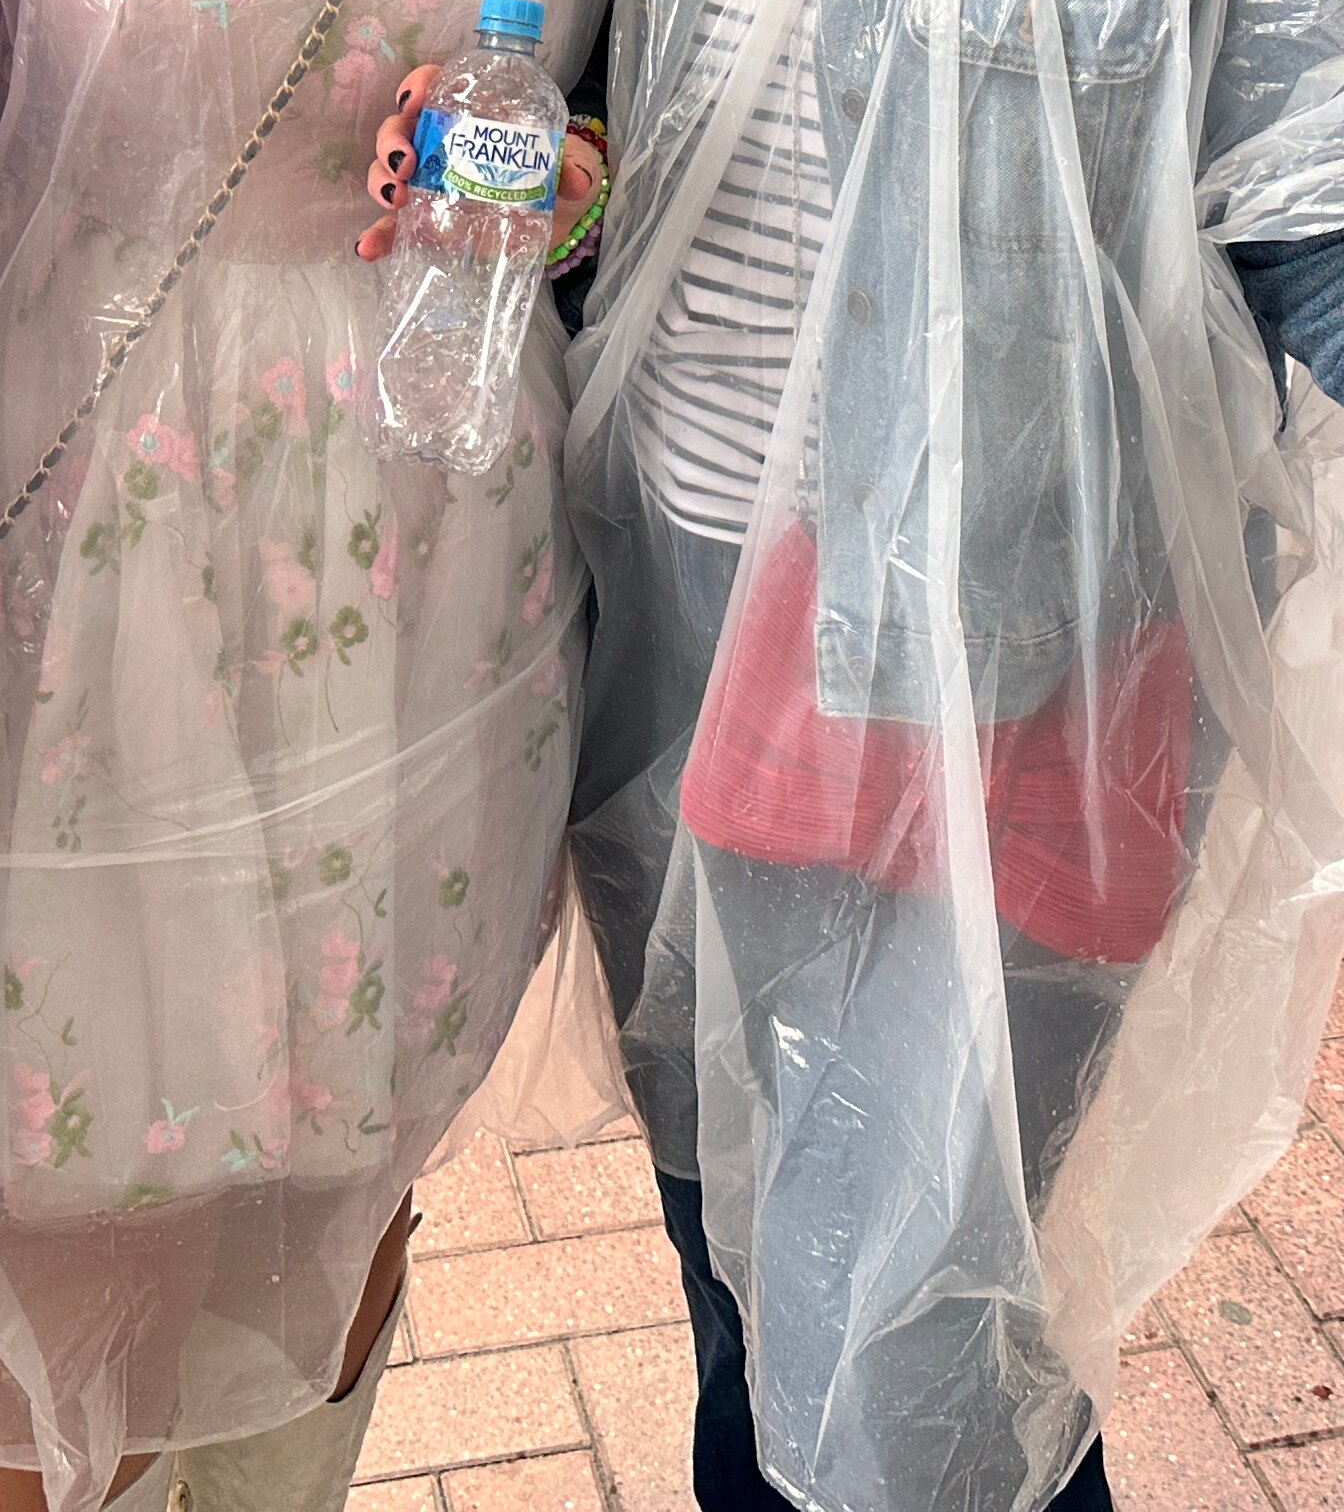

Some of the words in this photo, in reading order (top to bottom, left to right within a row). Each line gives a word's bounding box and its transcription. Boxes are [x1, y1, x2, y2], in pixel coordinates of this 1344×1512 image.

[474, 125, 539, 150] MOUNT
[450, 133, 550, 171] FRANKLIN
[474, 176, 527, 201] RECYCLED
